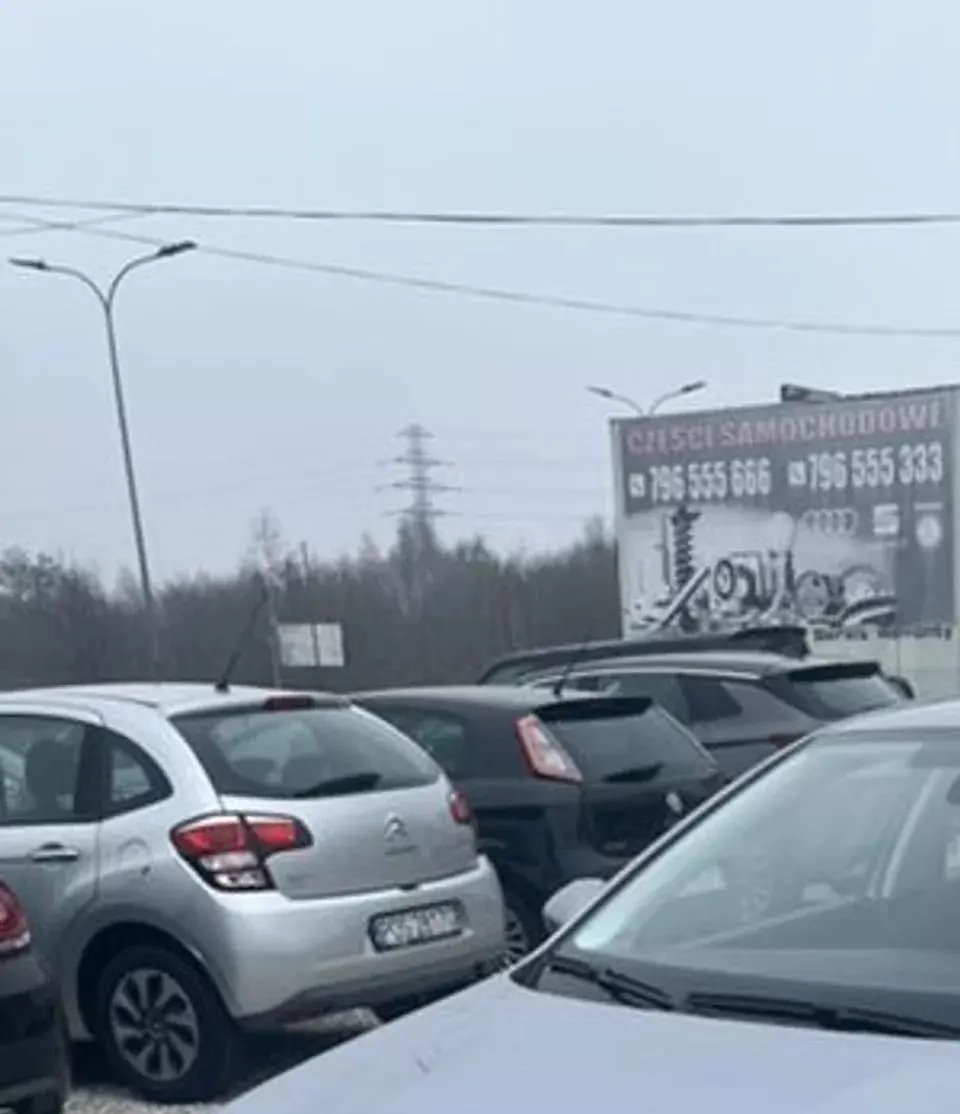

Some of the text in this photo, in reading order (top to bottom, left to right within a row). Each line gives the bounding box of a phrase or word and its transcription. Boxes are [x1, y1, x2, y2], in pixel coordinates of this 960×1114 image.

[649, 456, 770, 502] 796 555 666
[808, 441, 943, 491] 796 555 333
